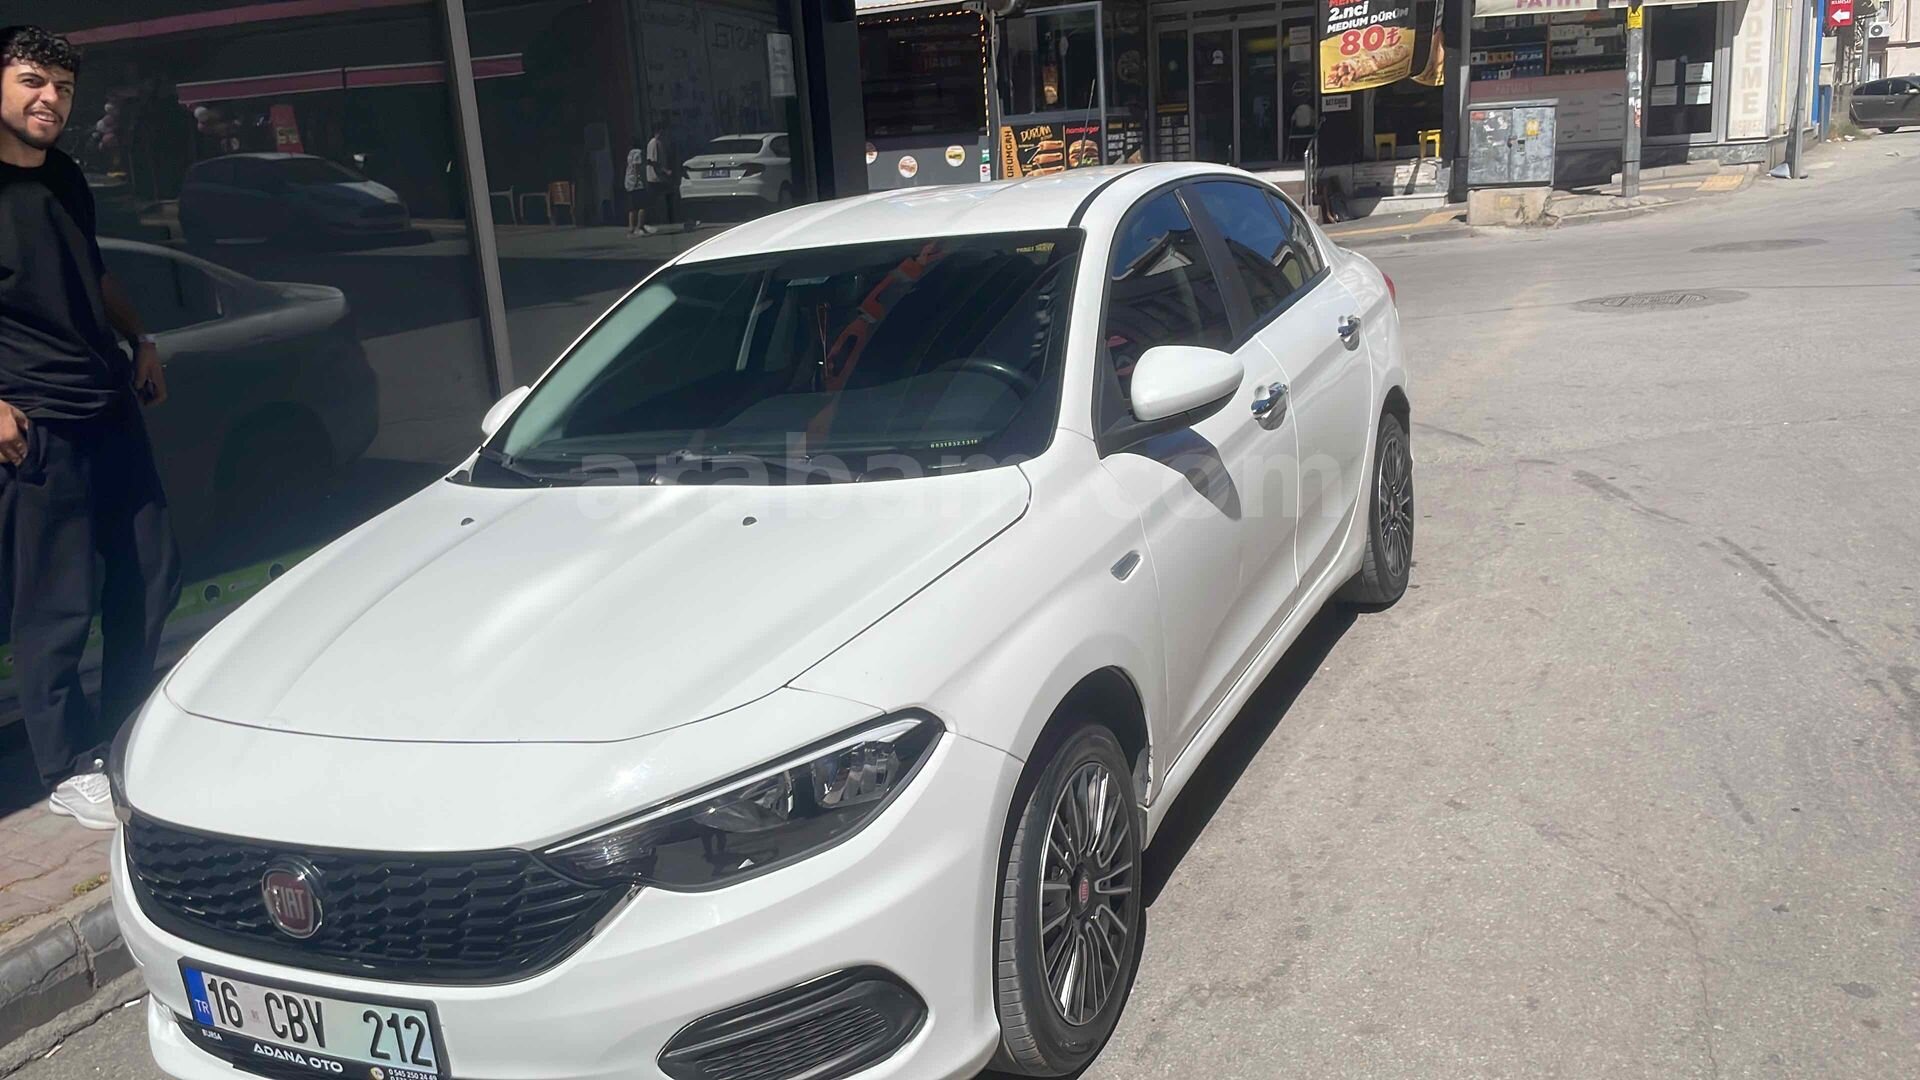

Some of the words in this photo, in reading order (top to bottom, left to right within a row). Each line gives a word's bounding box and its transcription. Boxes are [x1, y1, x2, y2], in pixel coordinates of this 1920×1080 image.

[1326, 17, 1369, 34] MEDIUM
[271, 885, 306, 920] FIAT
[194, 998, 211, 1015] TR
[207, 978, 243, 1028] 16
[264, 992, 325, 1048] CBV
[362, 1010, 432, 1067] 212
[253, 1042, 307, 1066] ADANA
[309, 1056, 344, 1074] OTO
